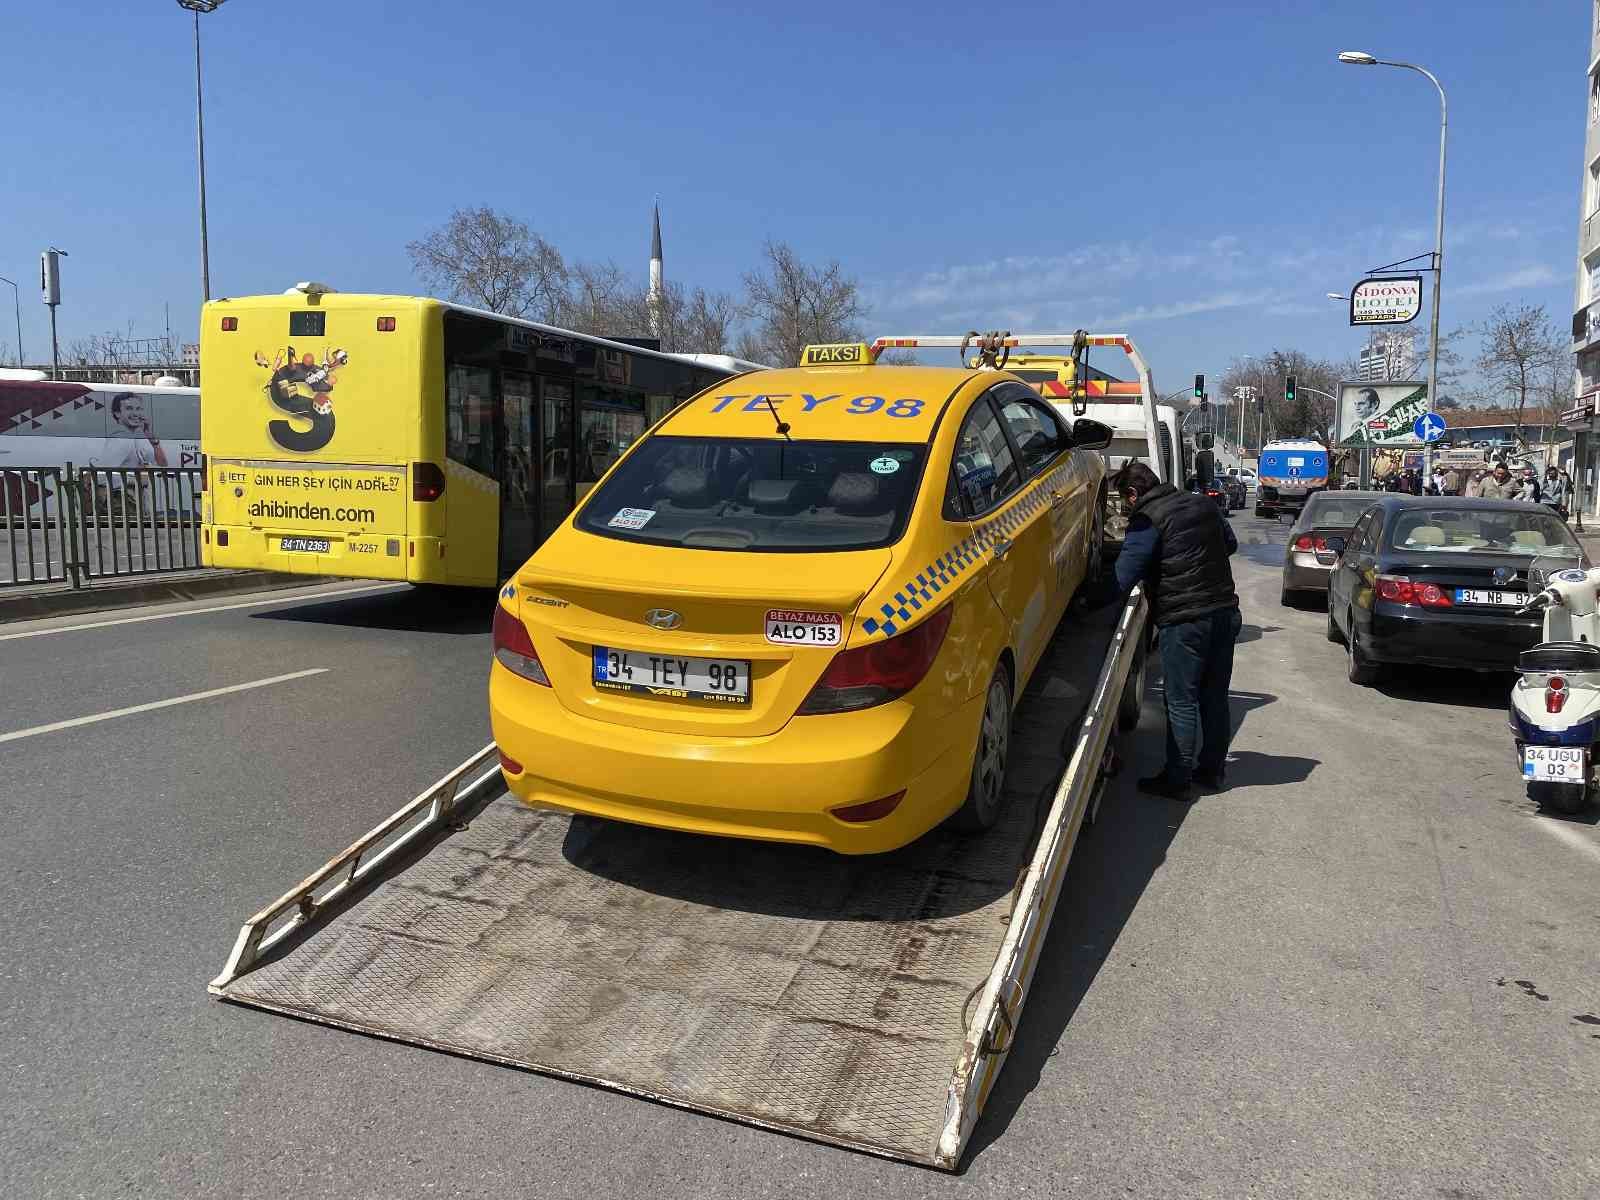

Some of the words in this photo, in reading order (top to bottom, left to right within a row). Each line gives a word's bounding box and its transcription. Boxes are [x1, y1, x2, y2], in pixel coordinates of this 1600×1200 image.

[846, 396, 925, 418] 98
[276, 475, 300, 487] HER
[303, 476, 325, 490] ŞEY
[247, 499, 375, 523] ahibinden.com
[282, 538, 292, 549] 34
[295, 539, 307, 550] TN
[307, 540, 328, 552] 2363
[349, 542, 379, 554] M-2257
[1463, 590, 1479, 602] 34
[1488, 591, 1502, 604] NB
[770, 611, 804, 622] BEYAZ
[806, 614, 838, 624] MASA
[770, 624, 807, 640] ALO
[811, 627, 836, 642] 153
[608, 652, 633, 680] 34
[649, 656, 689, 687] TEY
[708, 663, 737, 692] 98
[1527, 749, 1545, 761] 34
[1547, 764, 1566, 776] 03
